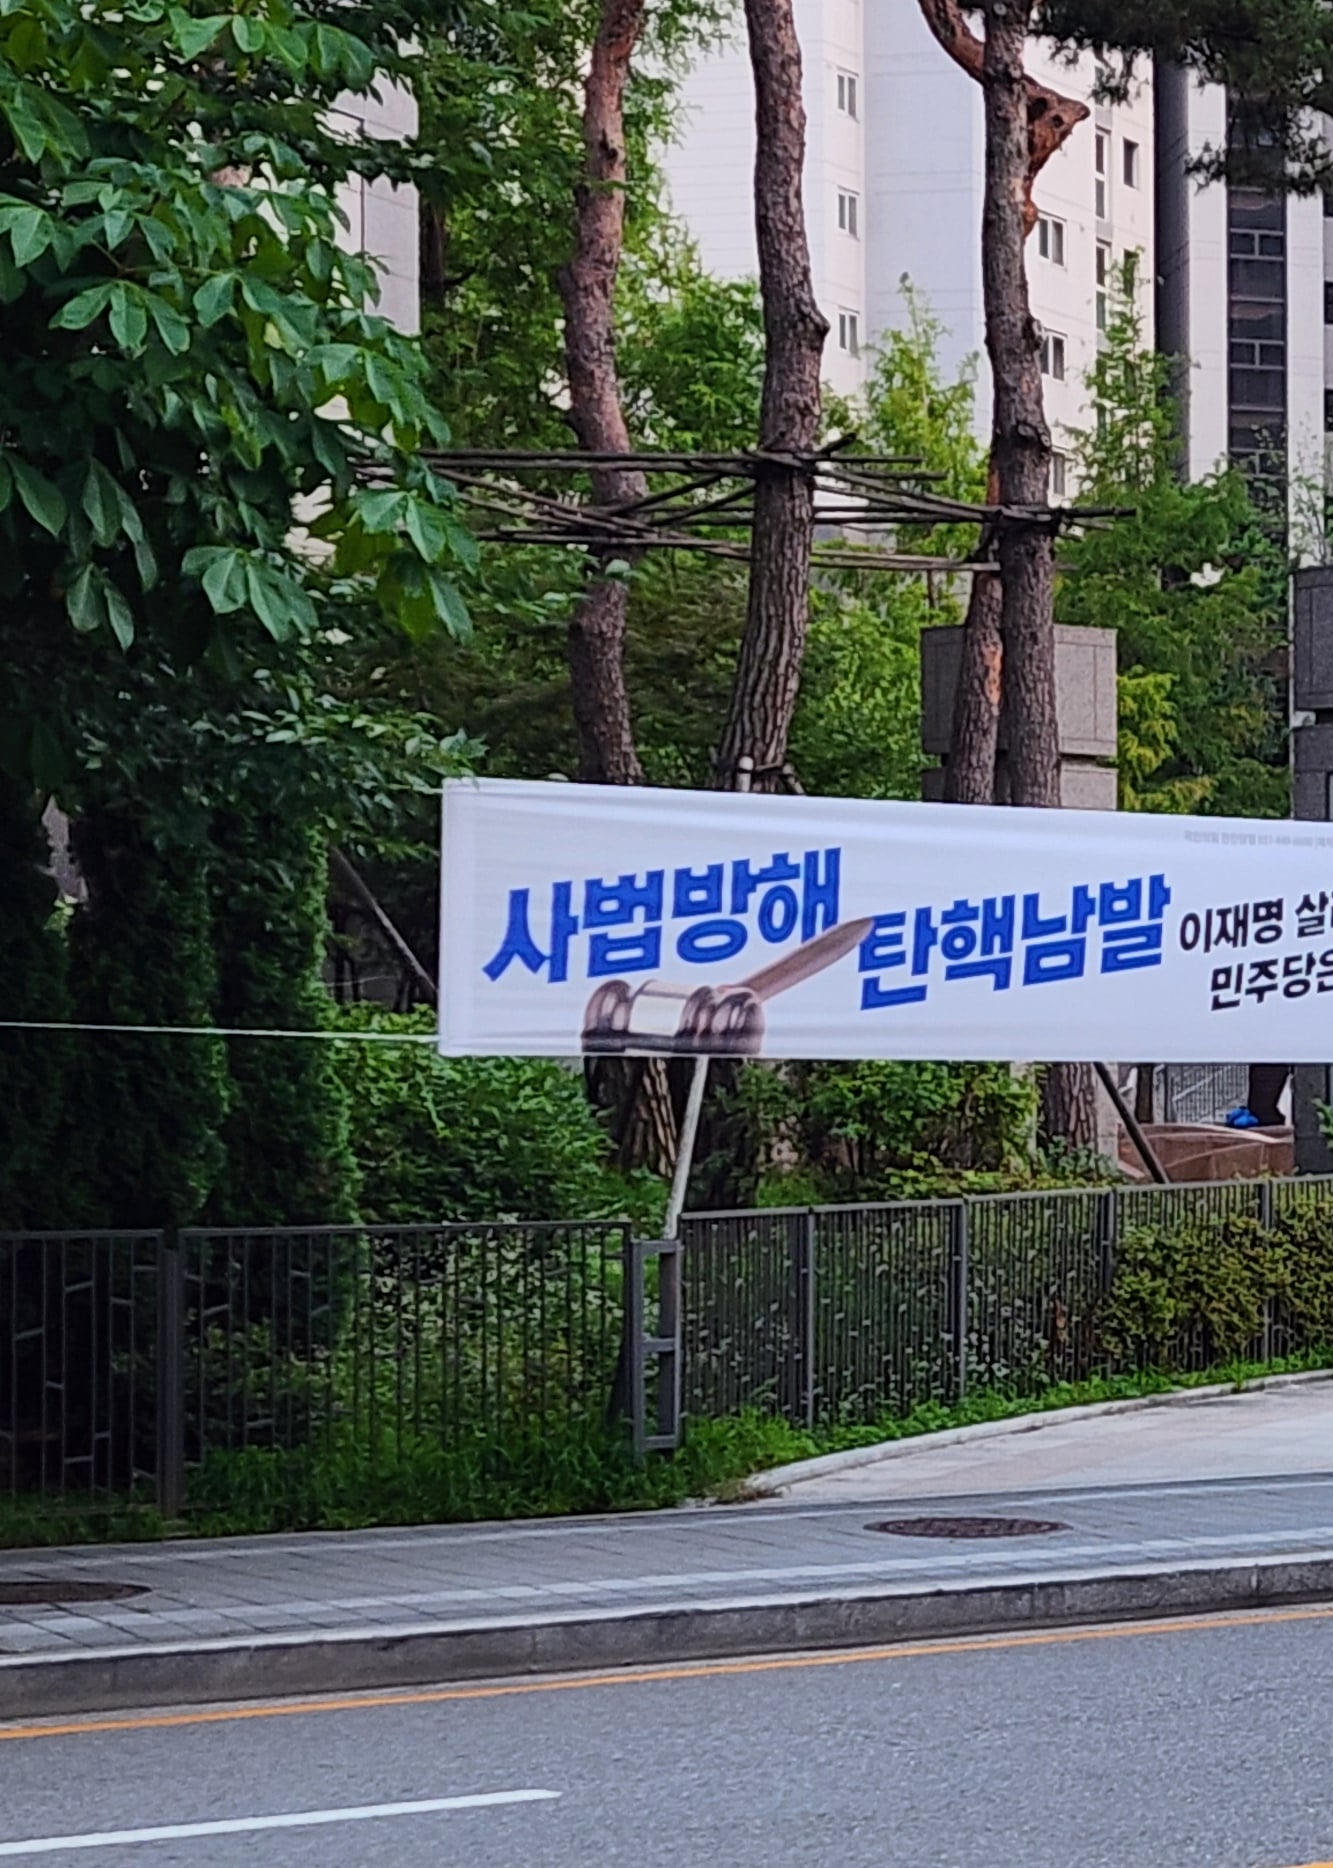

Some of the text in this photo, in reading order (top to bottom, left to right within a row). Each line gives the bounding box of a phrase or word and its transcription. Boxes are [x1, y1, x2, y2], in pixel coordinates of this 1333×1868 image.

[483, 847, 842, 984] 사법방해
[858, 873, 1171, 1011] 탄핵남발
[1179, 895, 1285, 954] 이재명
